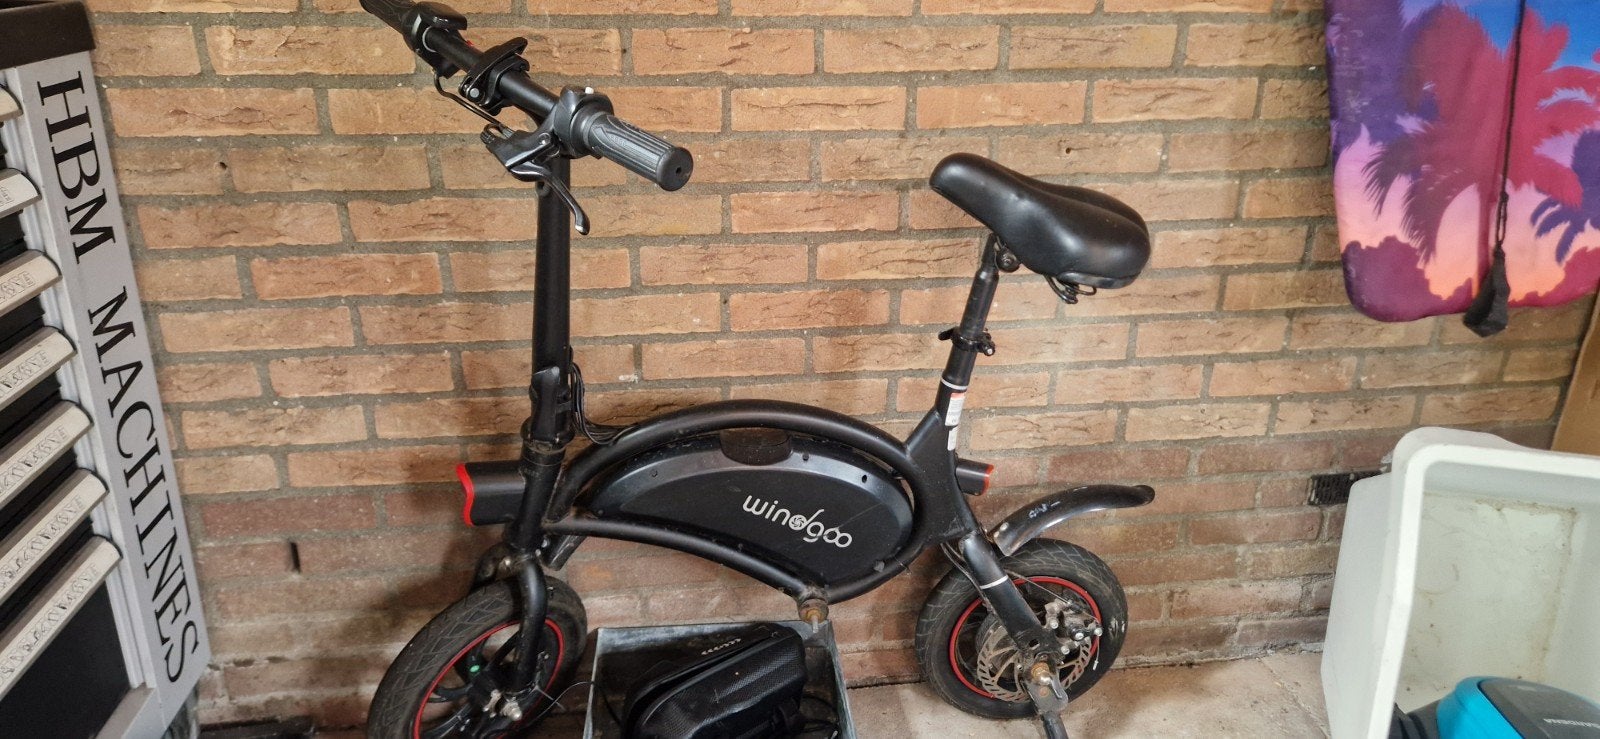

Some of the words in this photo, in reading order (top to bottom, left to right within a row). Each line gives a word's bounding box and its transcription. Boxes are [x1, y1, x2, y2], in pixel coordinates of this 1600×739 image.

[37, 71, 116, 264] HBM
[88, 286, 199, 683] MACHINES
[742, 495, 853, 548] windgoo
